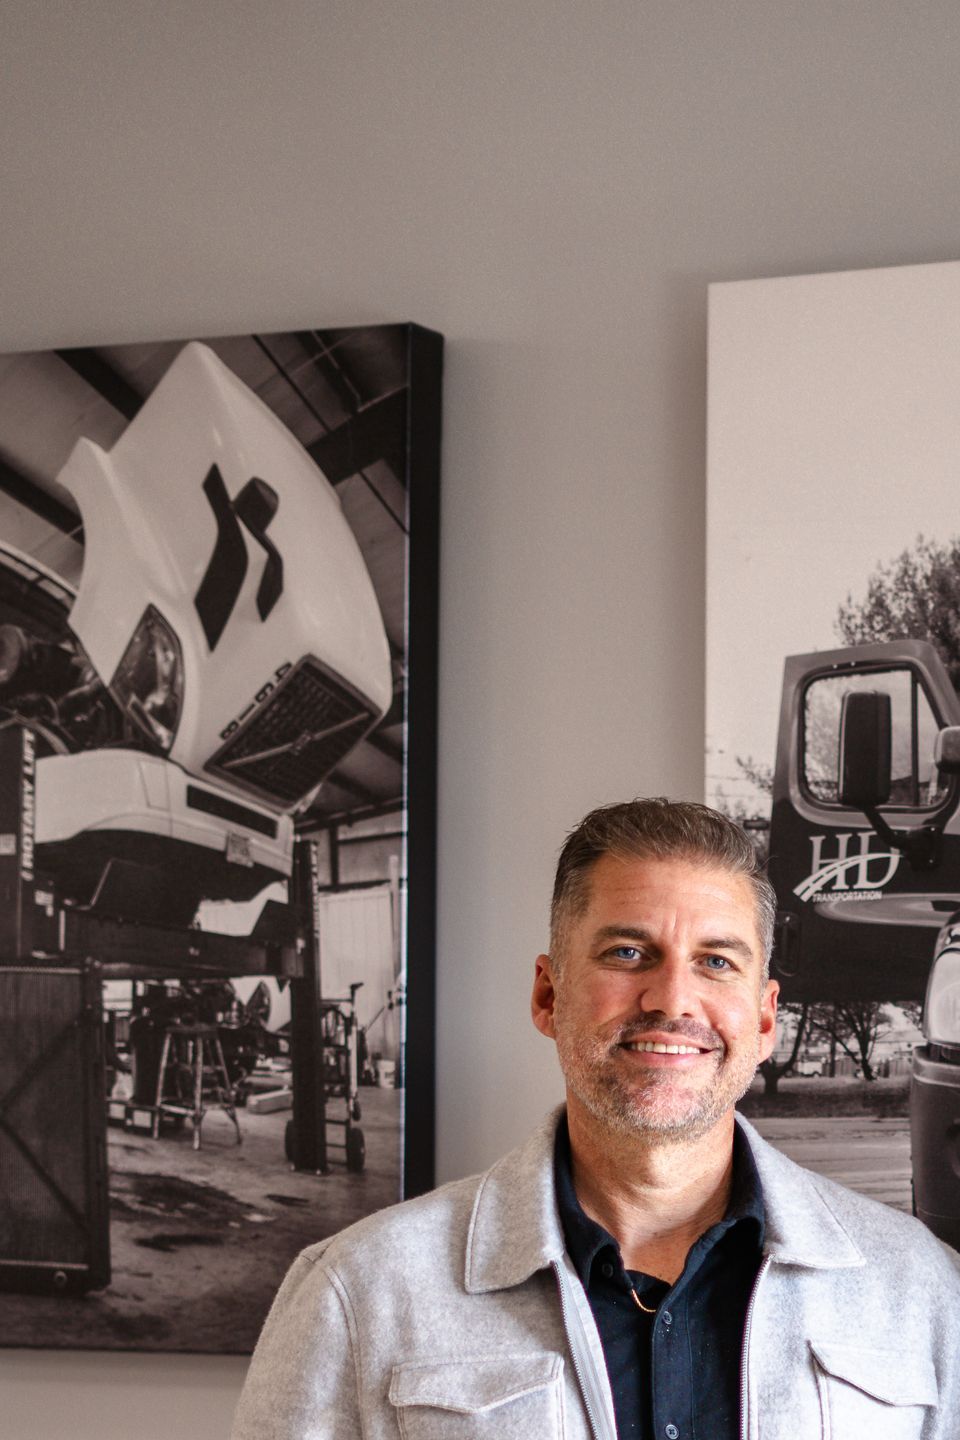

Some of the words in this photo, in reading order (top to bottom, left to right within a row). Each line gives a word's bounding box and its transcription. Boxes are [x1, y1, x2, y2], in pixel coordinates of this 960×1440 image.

[22, 728, 35, 776] LIFT
[22, 778, 34, 870] ROTARY
[809, 831, 900, 890] HD
[812, 890, 882, 902] TRANSPORTATION
